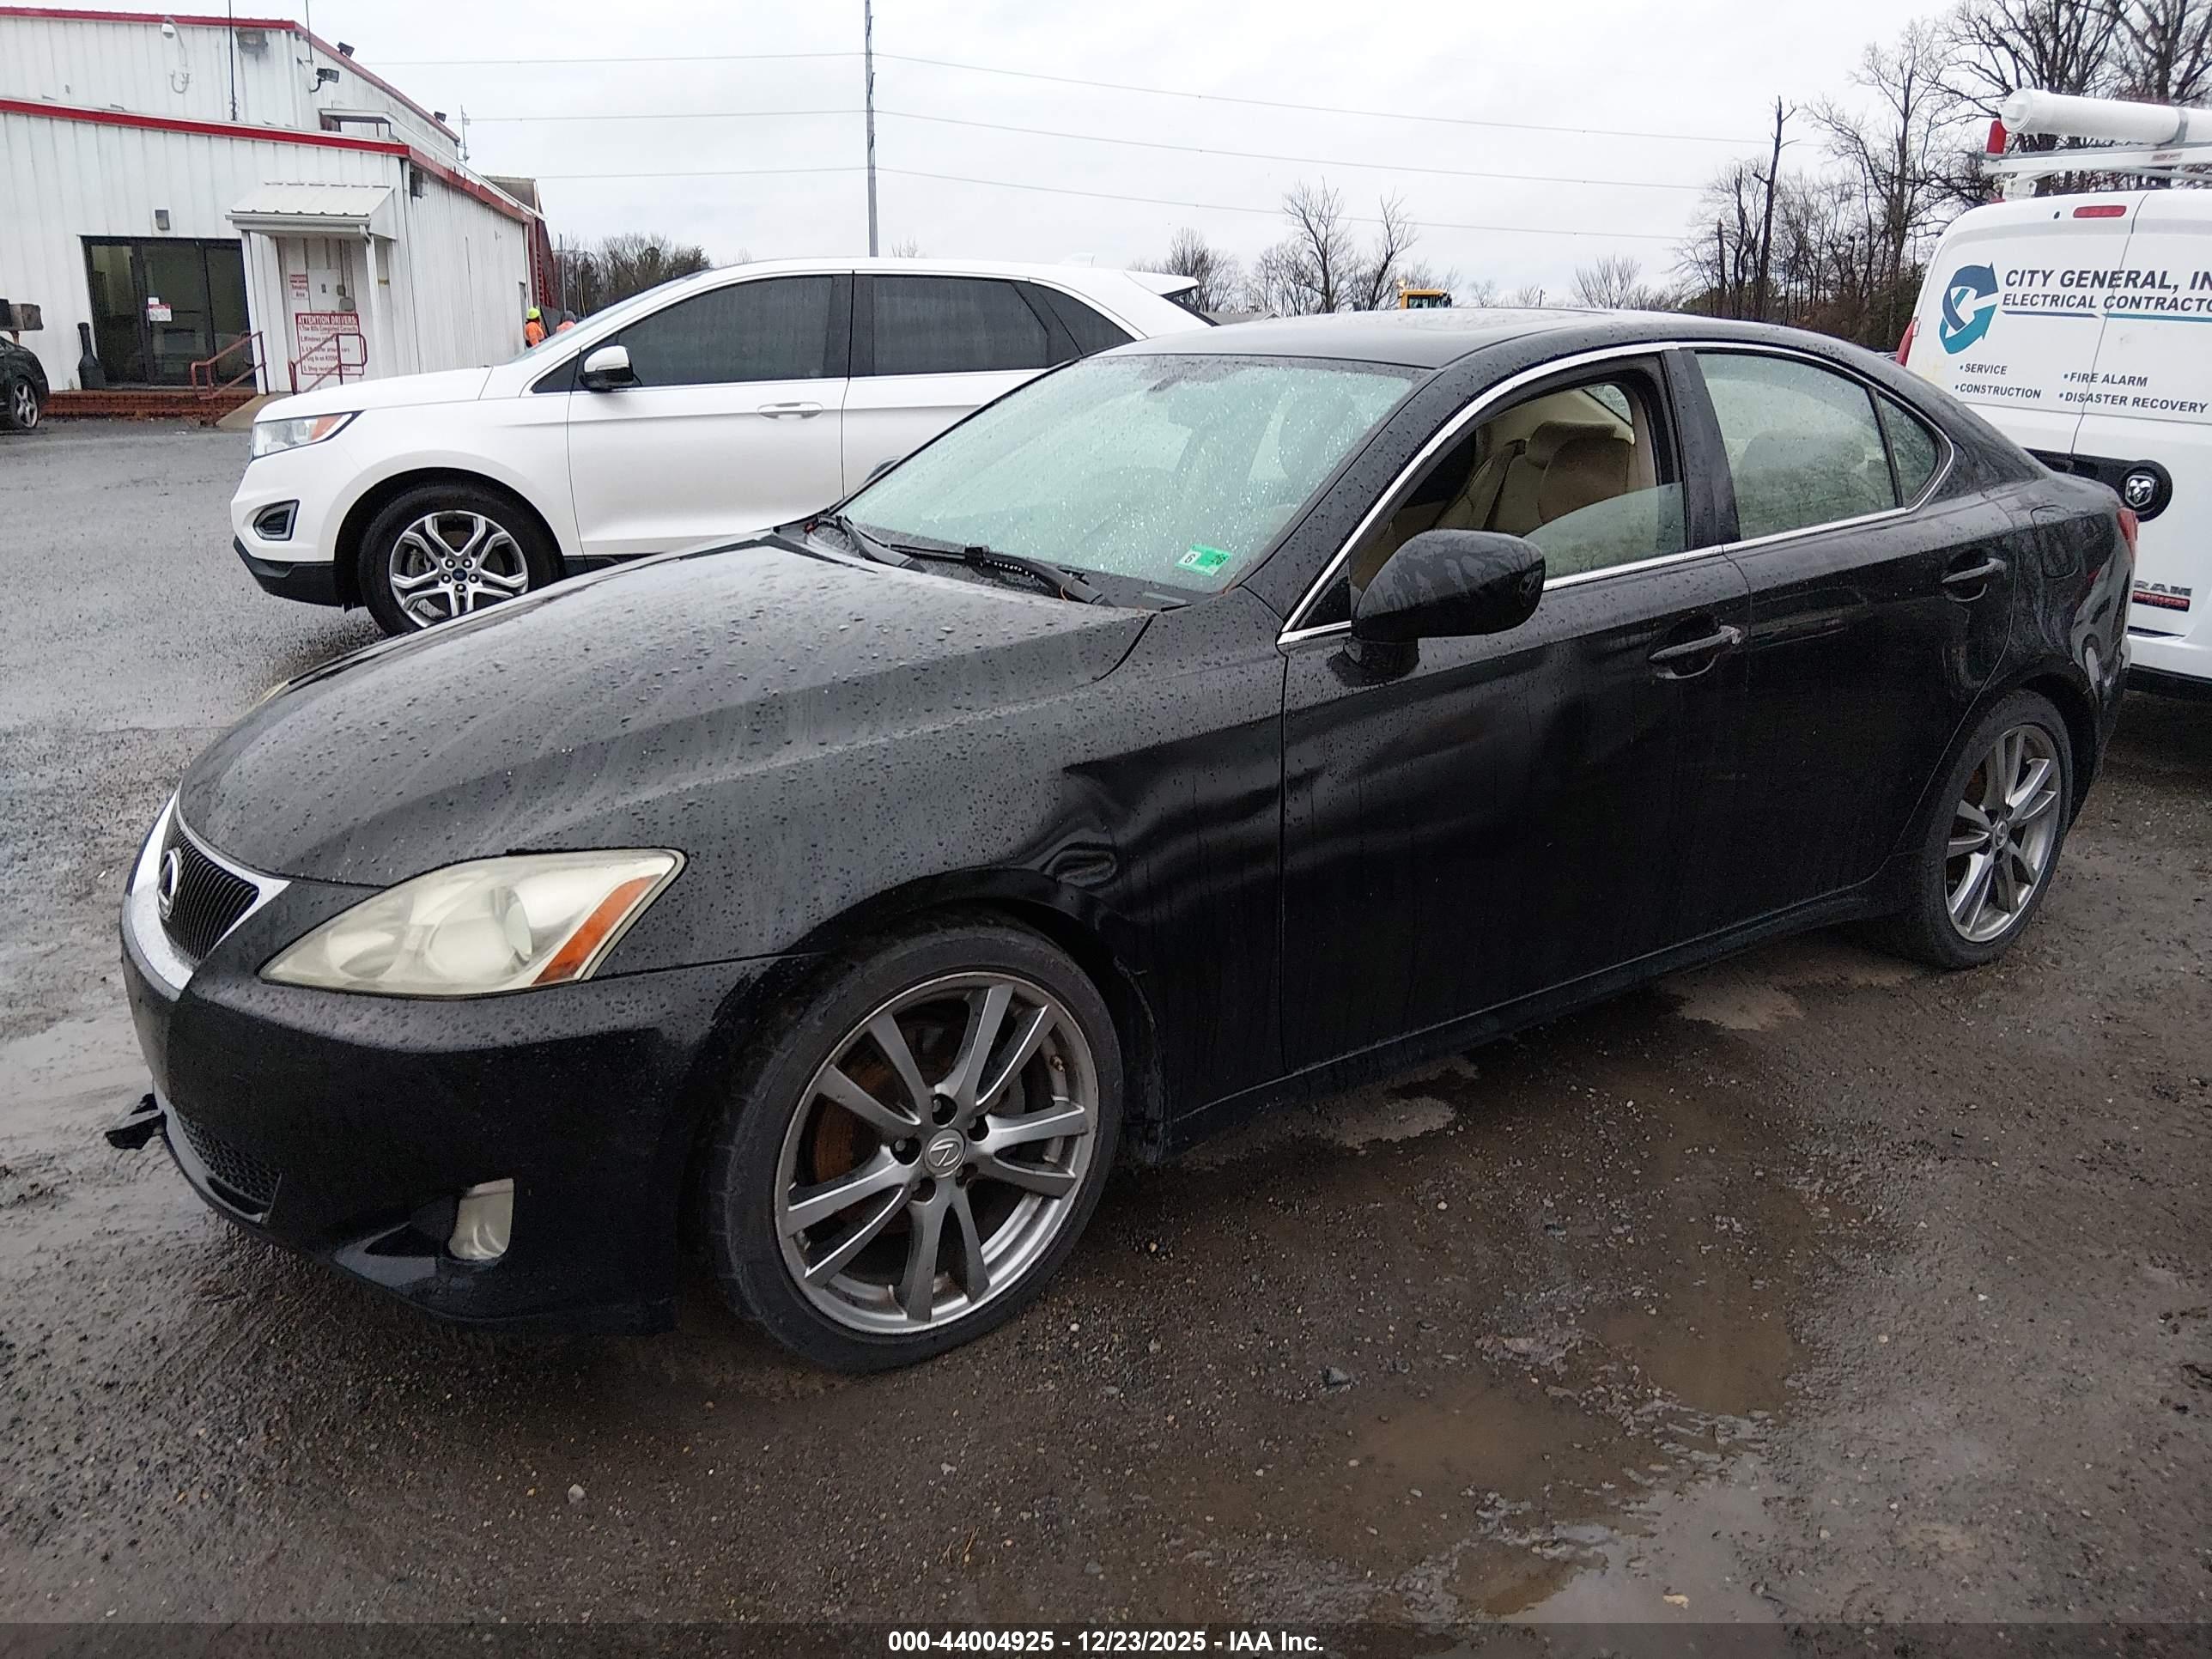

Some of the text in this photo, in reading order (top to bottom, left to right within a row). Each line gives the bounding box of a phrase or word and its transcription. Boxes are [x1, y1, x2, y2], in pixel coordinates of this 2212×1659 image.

[2005, 270, 2055, 287] CITY
[2060, 270, 2179, 295] GENERAL,
[2002, 294, 2097, 308] ELECTRICAL
[298, 315, 330, 325] ATTENTION
[1964, 363, 2008, 375] SERVICE
[2069, 372, 2148, 387] FIRE ALARM
[1960, 383, 2042, 399] CONSTRUCTION
[2064, 392, 2209, 414] DISASTER RECOVERY
